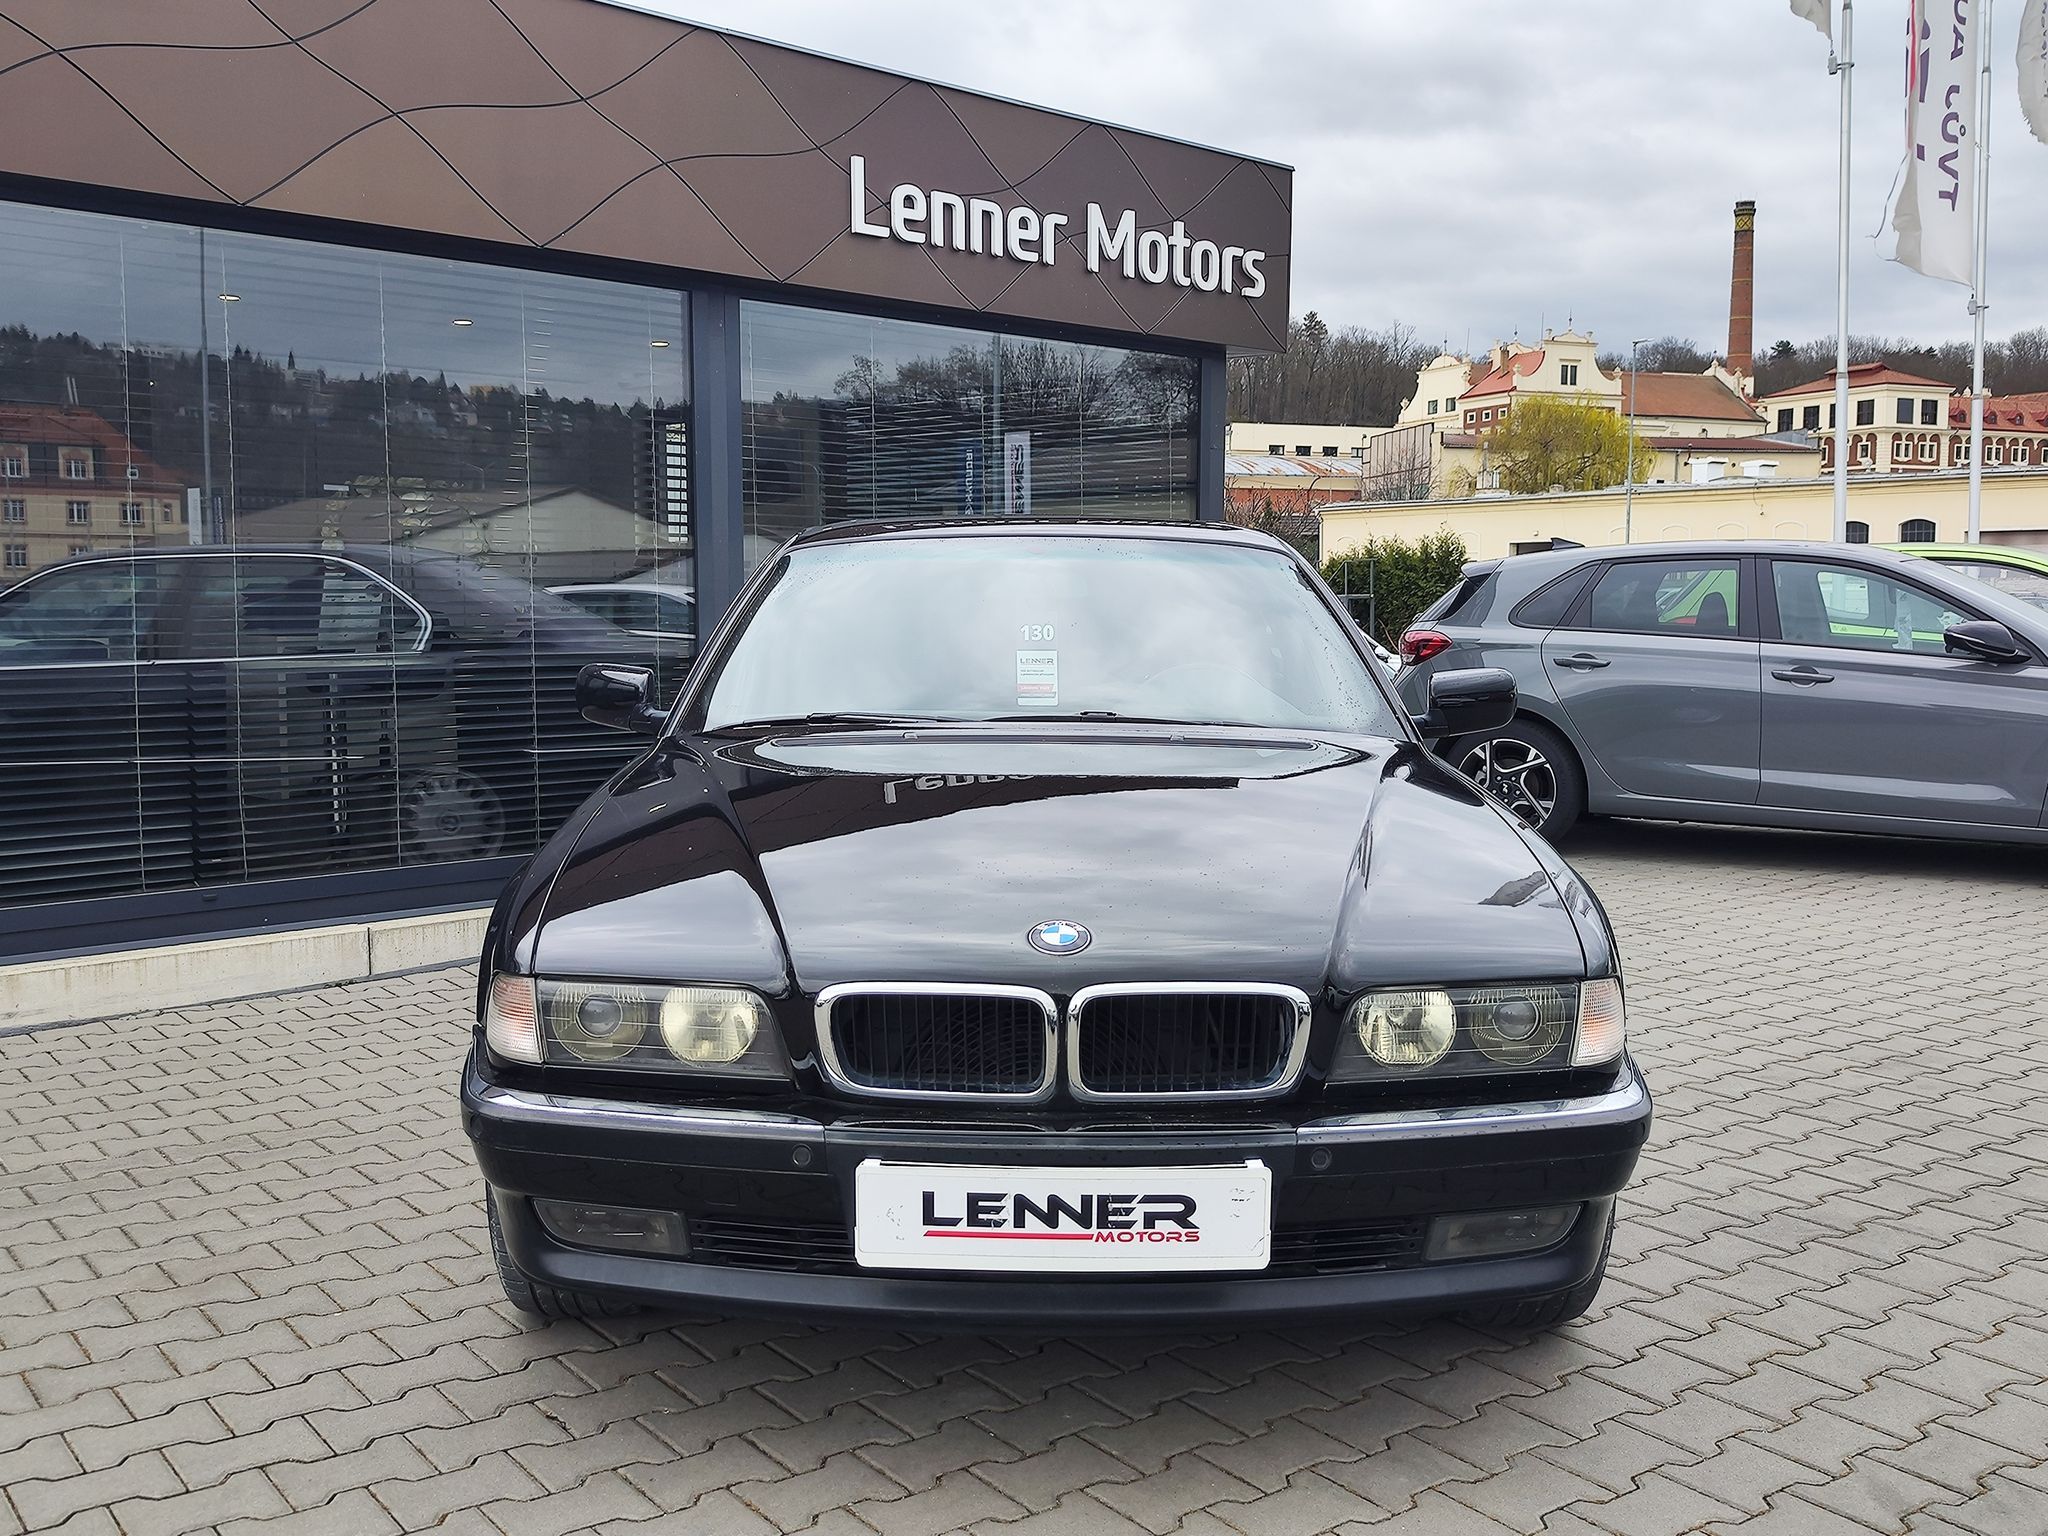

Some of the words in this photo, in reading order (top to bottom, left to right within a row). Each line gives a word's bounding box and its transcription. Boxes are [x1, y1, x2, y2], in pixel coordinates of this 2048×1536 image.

[849, 154, 1069, 266] Lenner
[1085, 201, 1266, 298] Motors
[1020, 624, 1055, 641] 130
[922, 1190, 1200, 1229] LENNER
[1094, 1231, 1200, 1243] MOTORS
